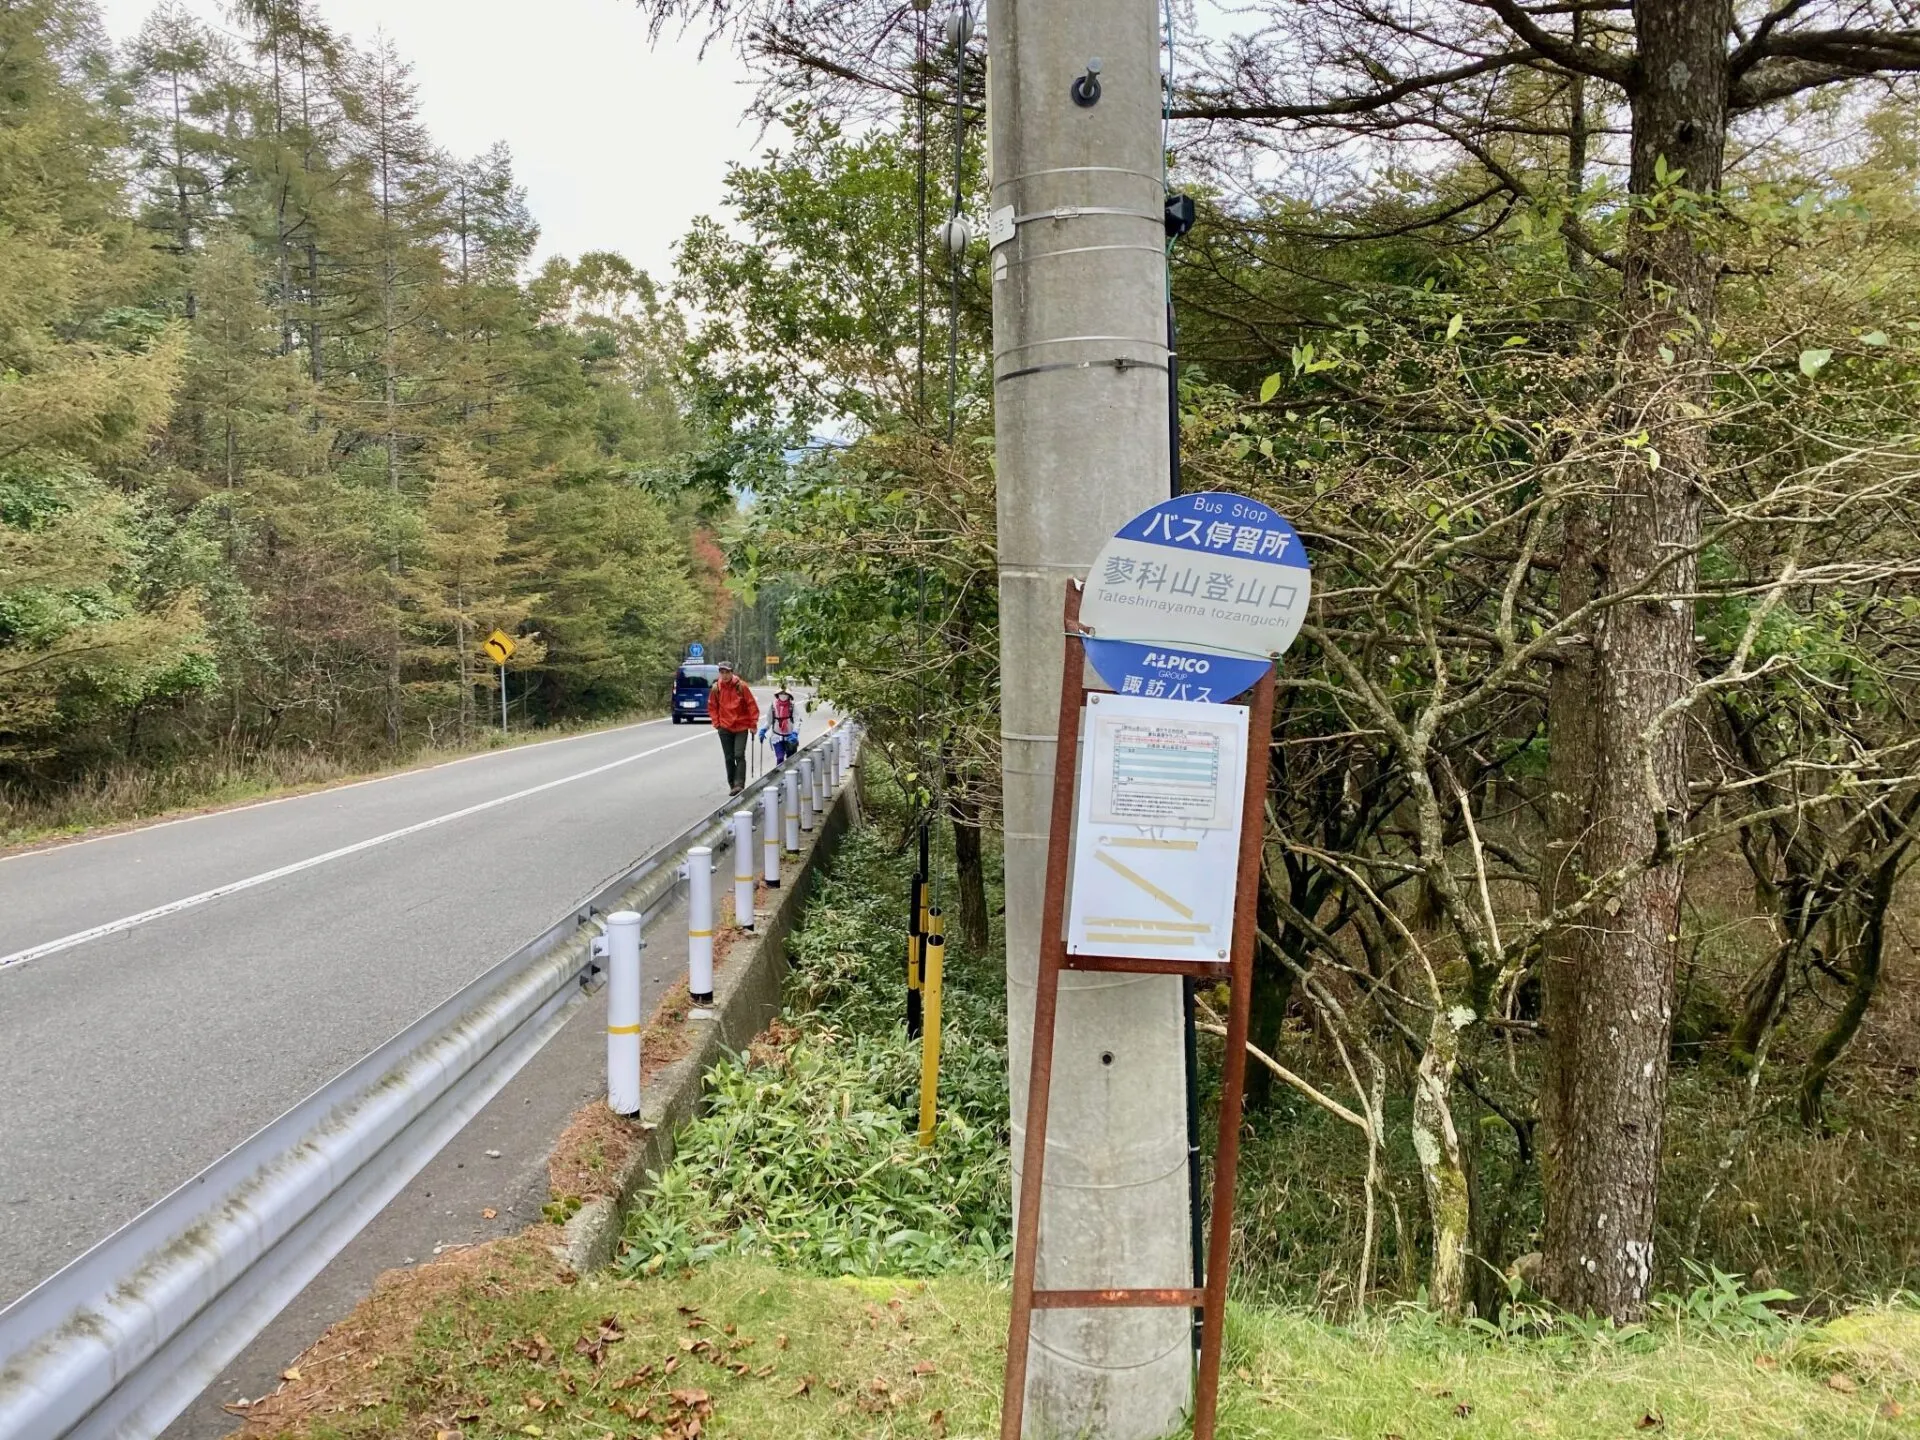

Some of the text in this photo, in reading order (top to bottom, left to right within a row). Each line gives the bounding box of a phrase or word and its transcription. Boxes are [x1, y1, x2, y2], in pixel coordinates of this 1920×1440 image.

[1193, 497, 1268, 523] Bus Stop
[1142, 511, 1292, 559] バス停留所
[1103, 555, 1298, 611] 蓼科山登山口
[1097, 588, 1290, 629] Tateshinayama tozanguchi
[1142, 652, 1210, 674] ALPICO
[1158, 670, 1188, 682] GROUP
[1121, 674, 1213, 704] 諏訪バス
